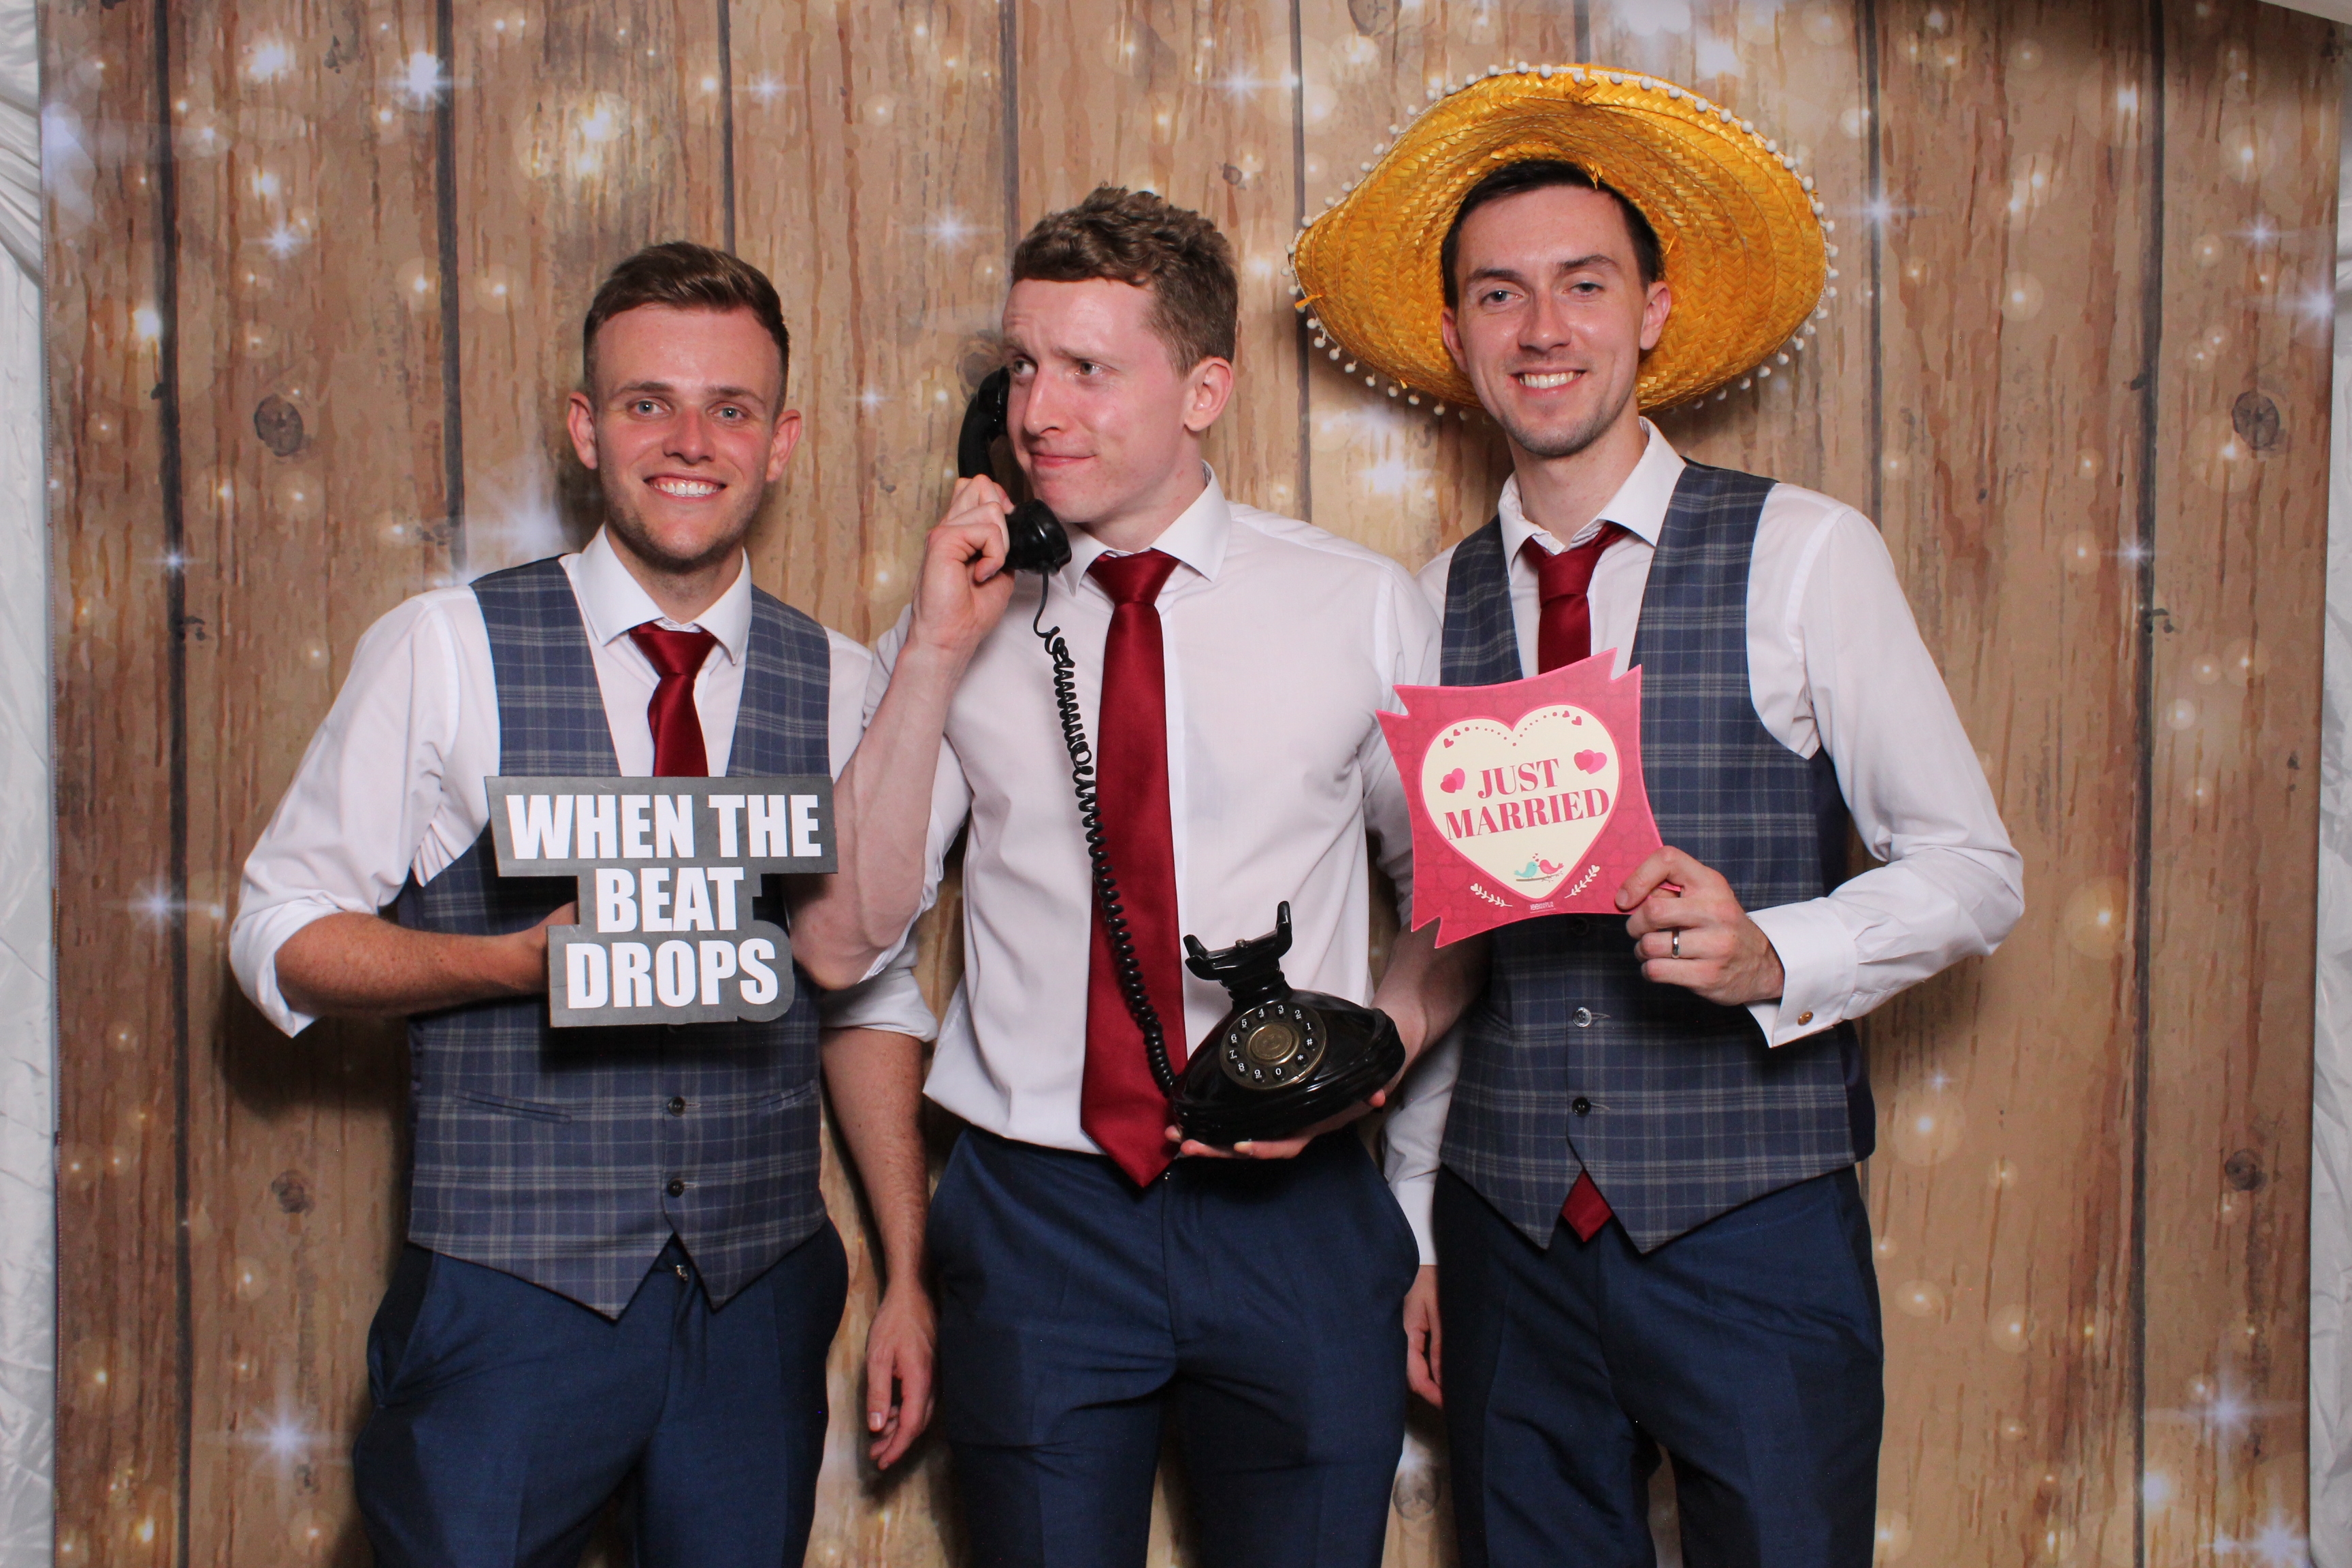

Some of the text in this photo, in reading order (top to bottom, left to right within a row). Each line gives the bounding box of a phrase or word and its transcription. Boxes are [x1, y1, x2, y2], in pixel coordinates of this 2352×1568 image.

[1477, 758, 1560, 799] JUST
[506, 794, 822, 860] WHEN THE
[1443, 787, 1610, 840] MARRIED
[595, 866, 745, 933] BEAT
[566, 938, 779, 1009] DROPS
